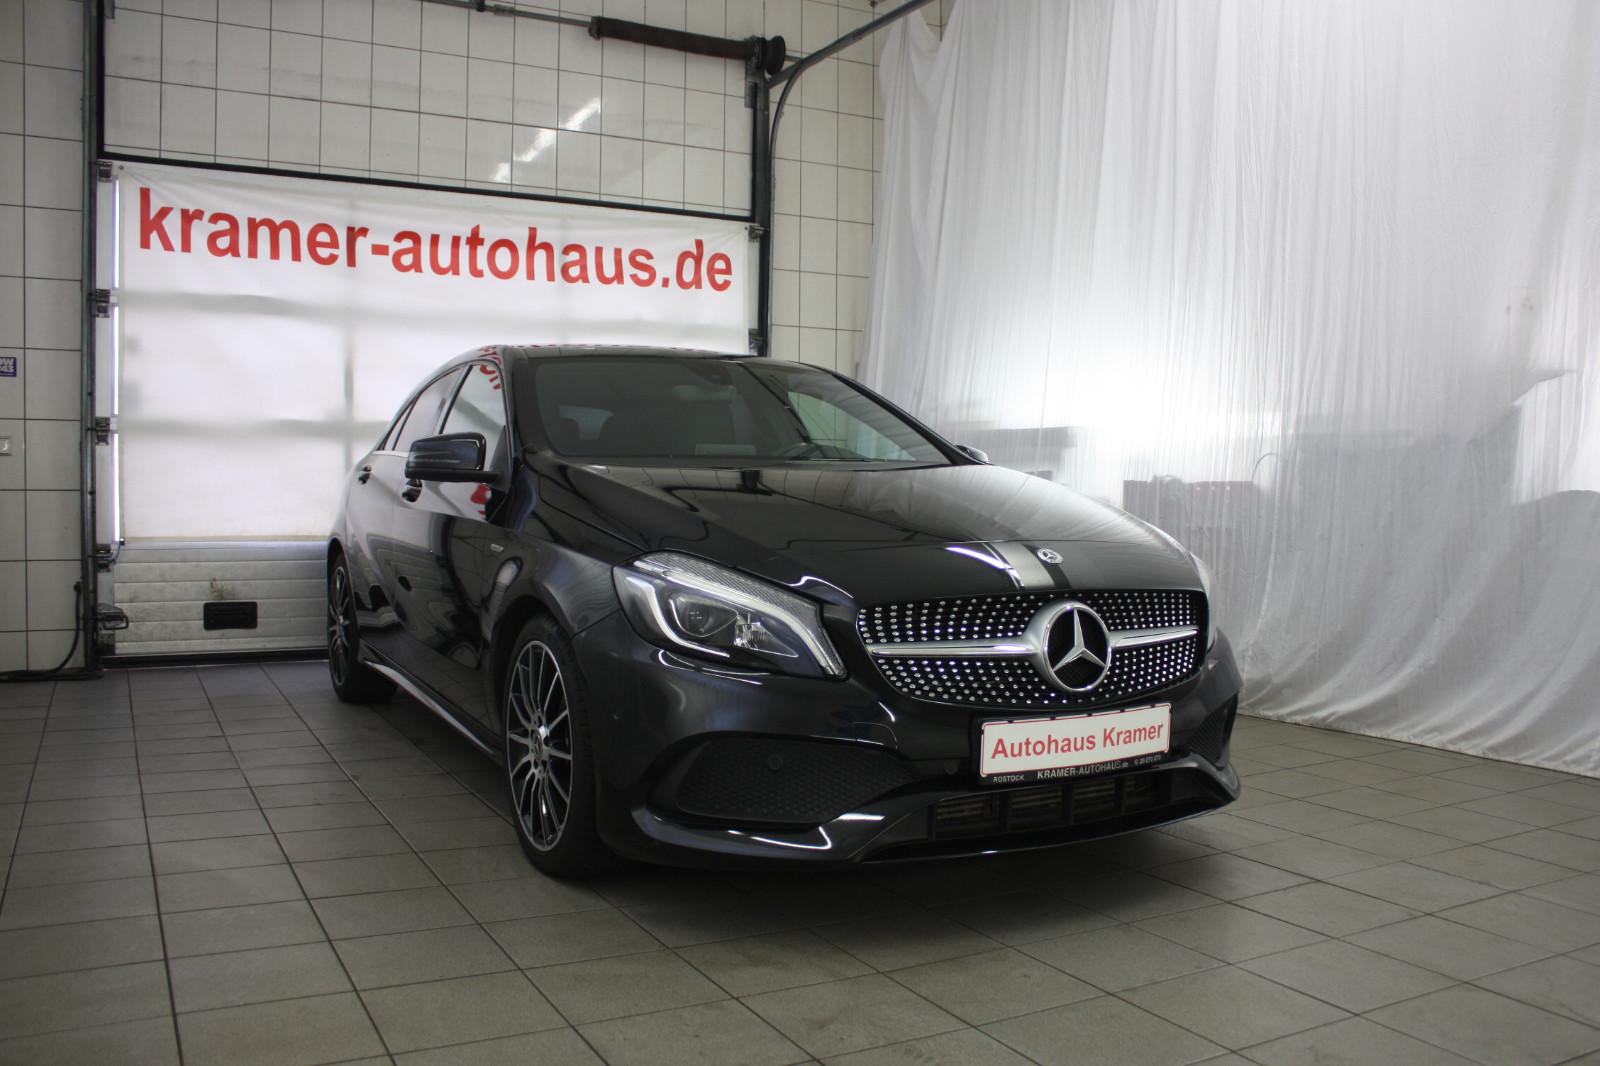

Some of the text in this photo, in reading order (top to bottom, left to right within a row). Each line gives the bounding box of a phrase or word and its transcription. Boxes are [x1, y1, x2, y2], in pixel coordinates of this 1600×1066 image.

[139, 187, 733, 292] kramer-autohaus.de
[991, 722, 1164, 759] Autohaus Kramer
[993, 774, 1025, 783] ROSTOCK
